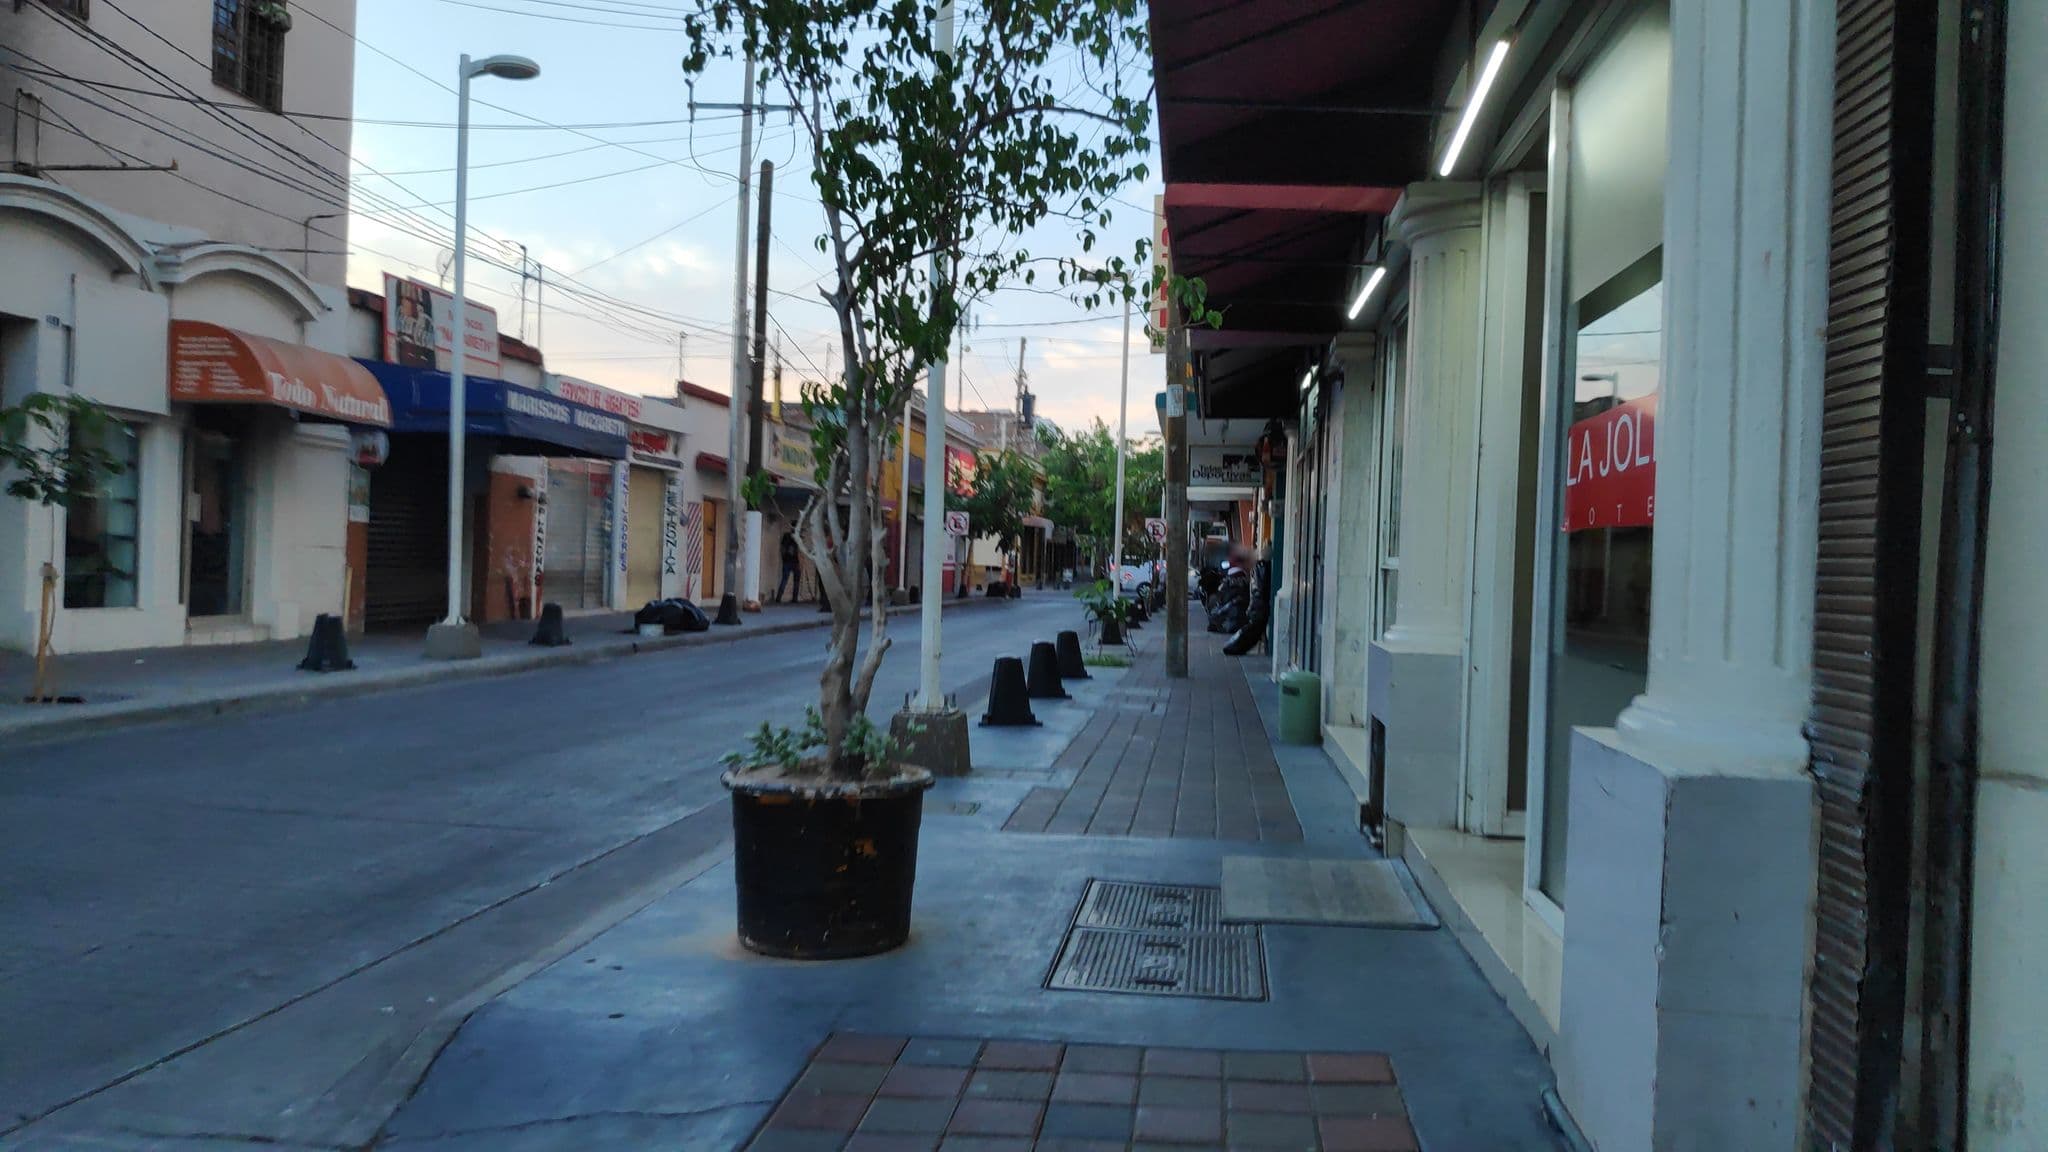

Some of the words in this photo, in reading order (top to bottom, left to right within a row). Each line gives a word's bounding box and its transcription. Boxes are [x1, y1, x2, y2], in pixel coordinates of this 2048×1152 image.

[267, 371, 317, 408] Todo
[320, 382, 389, 424] Natural
[507, 389, 571, 425] MARISCOS
[1566, 429, 1594, 487] LA
[1599, 407, 1656, 477] JOL
[1192, 469, 1252, 482] Deportivas
